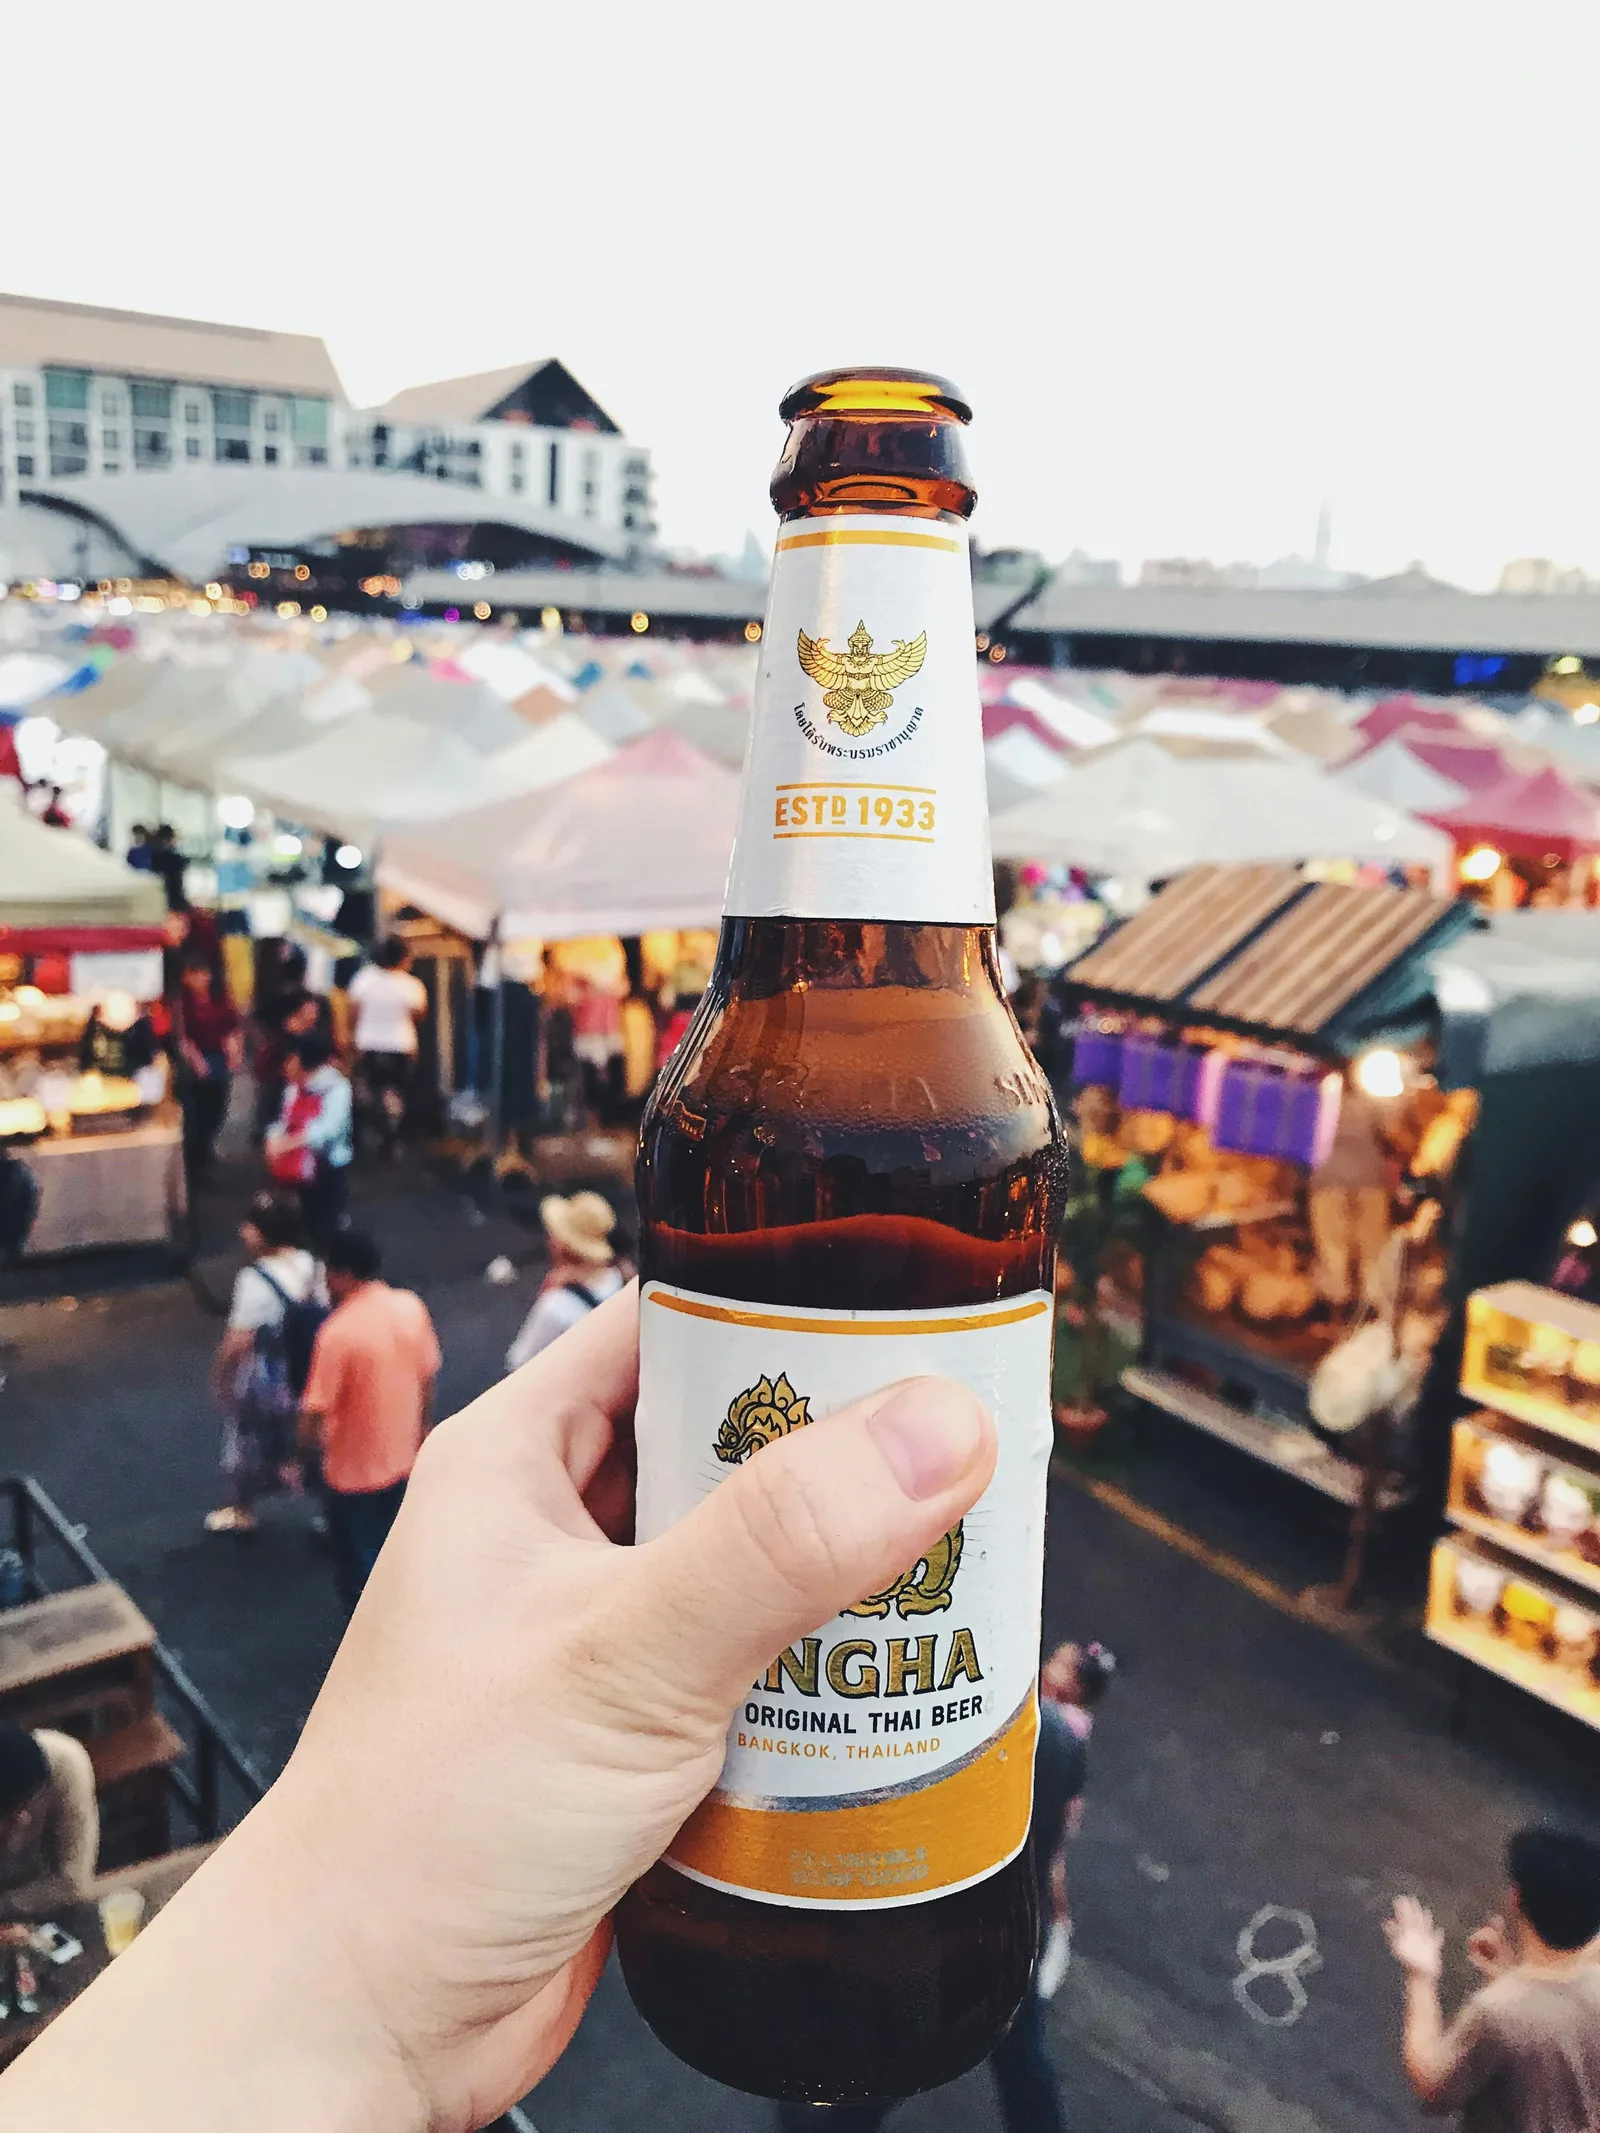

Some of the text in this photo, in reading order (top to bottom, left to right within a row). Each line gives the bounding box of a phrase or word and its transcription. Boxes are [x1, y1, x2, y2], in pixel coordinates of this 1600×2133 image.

[775, 795, 935, 831] ESTD 1933
[752, 1627, 985, 1699] NGHA
[744, 1695, 983, 1734] ORIGINAL THAI BEER
[737, 1731, 941, 1761] BANGKOK, THAILAND
